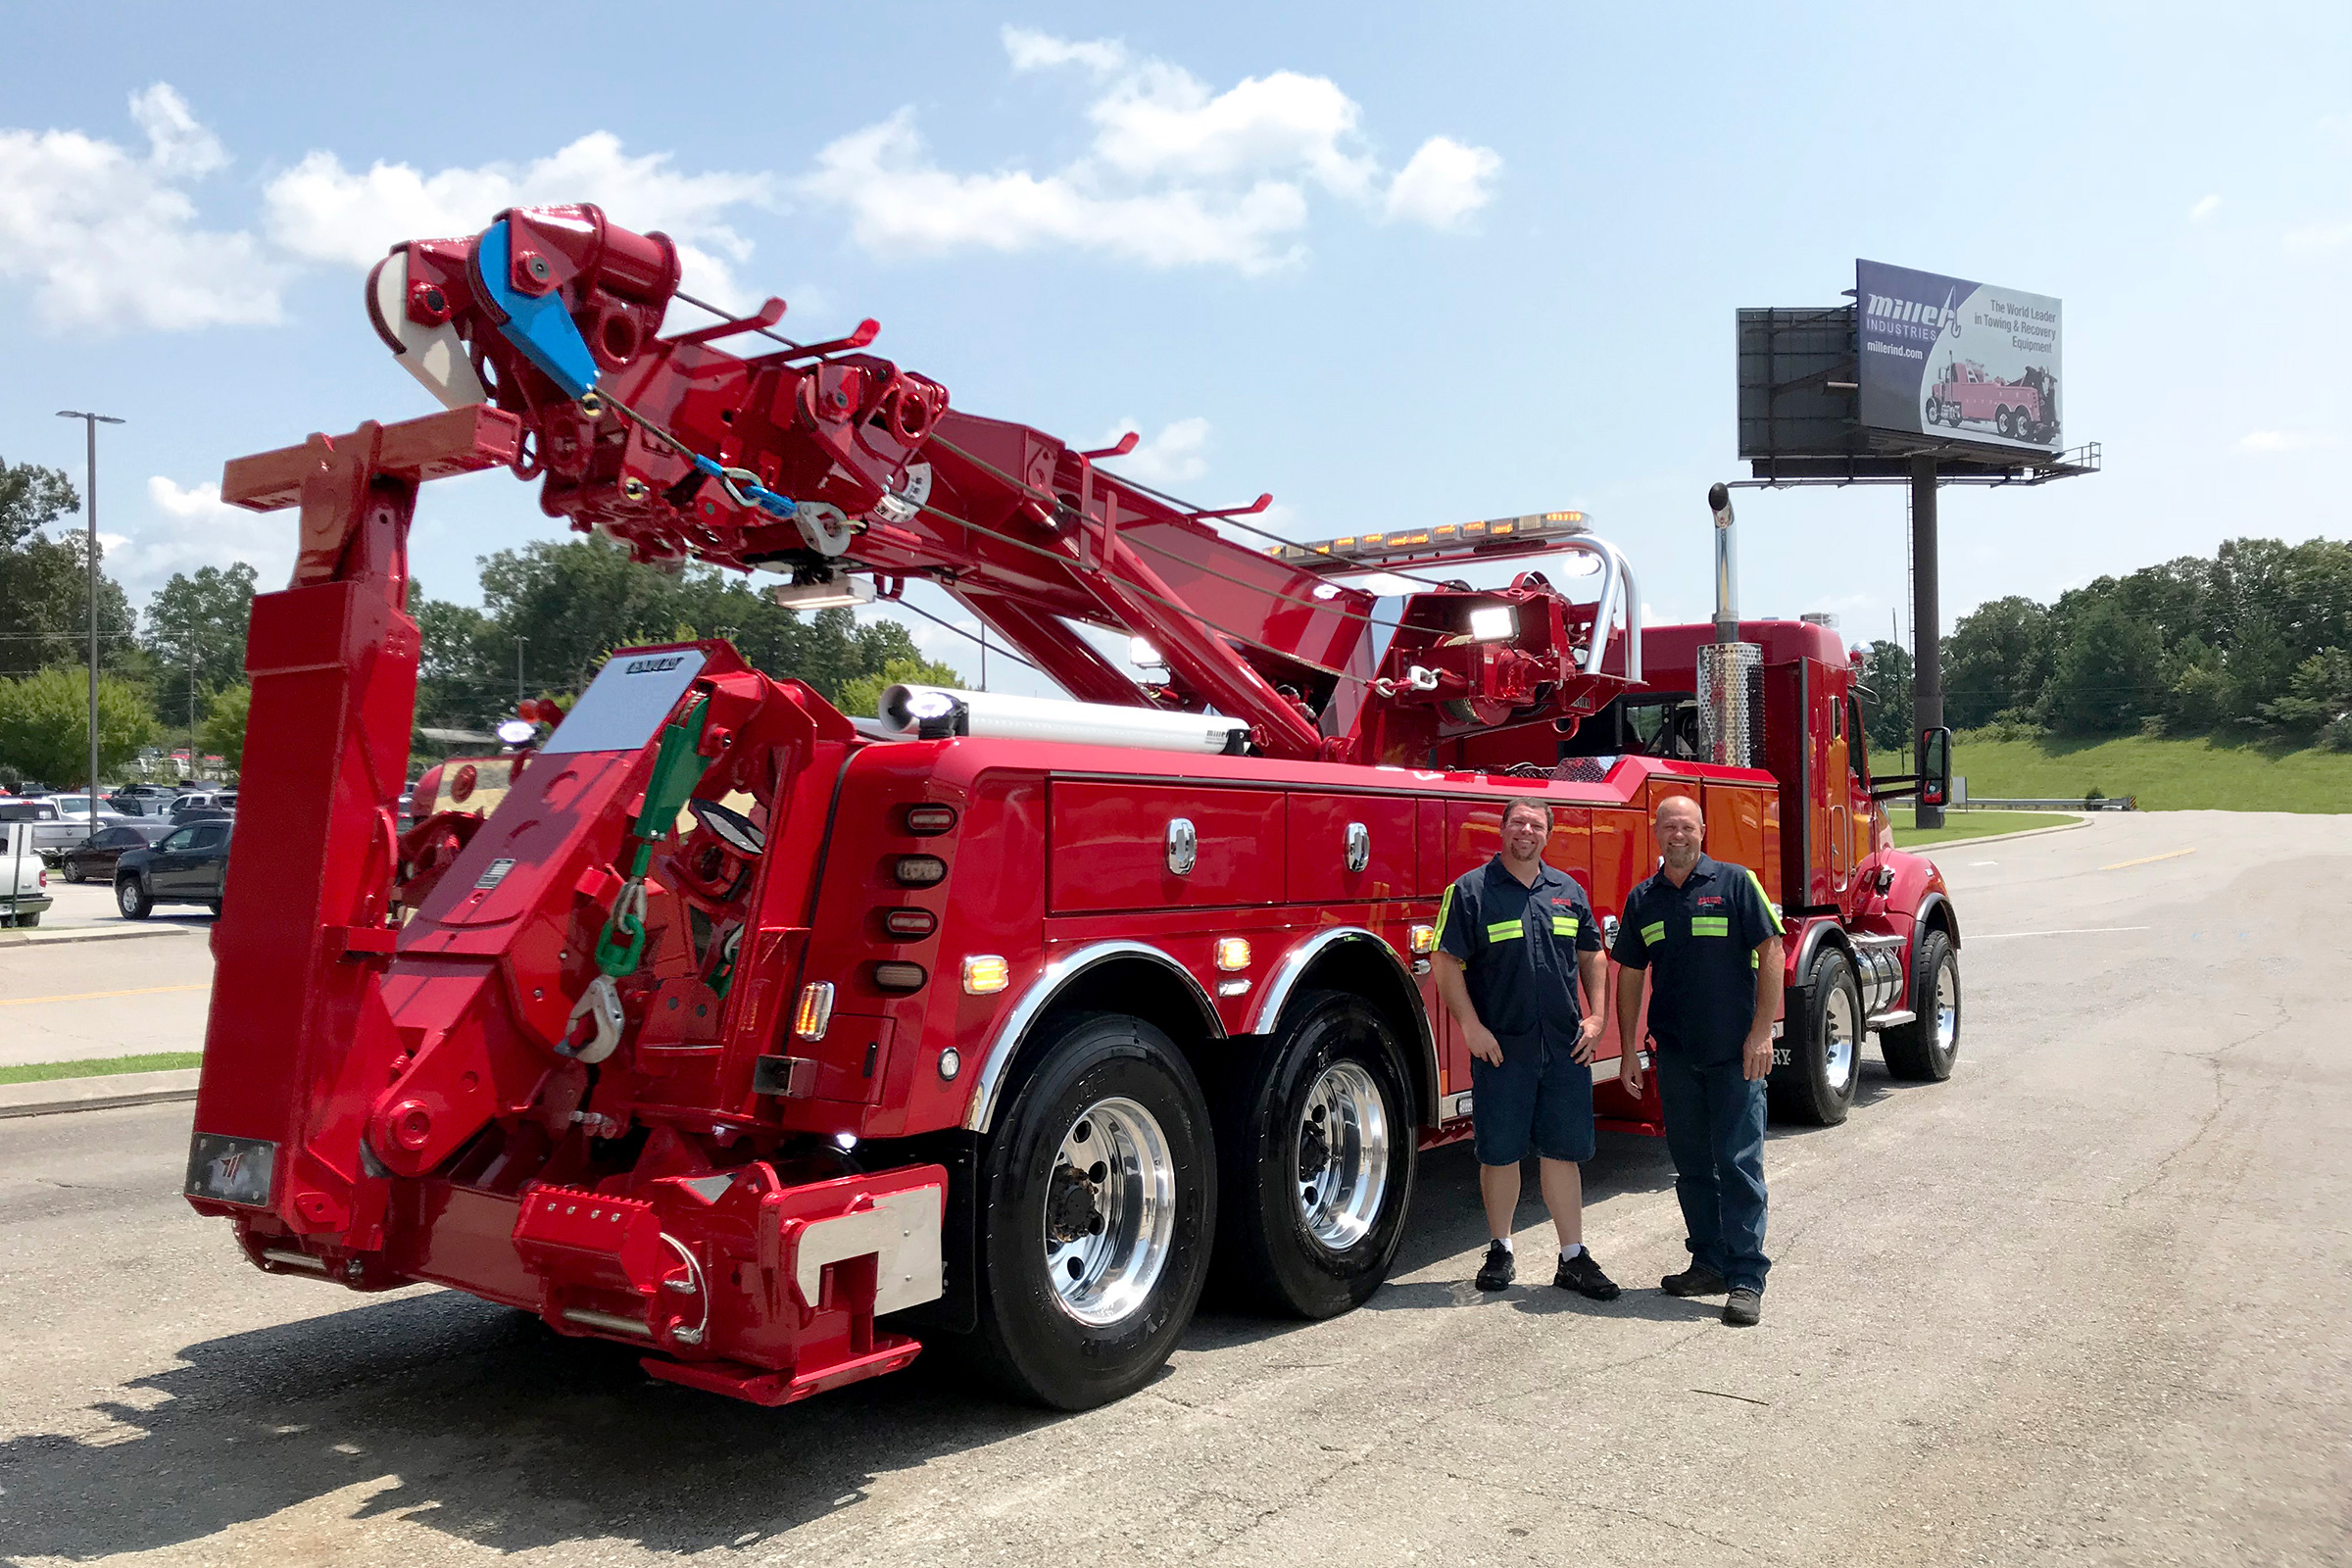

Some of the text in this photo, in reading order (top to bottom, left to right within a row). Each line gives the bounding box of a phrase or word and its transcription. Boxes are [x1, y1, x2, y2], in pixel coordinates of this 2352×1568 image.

[1990, 299, 2056, 323] The World Leader
[1866, 318, 1937, 341] INDUSTRIES
[1974, 312, 2056, 341] in Towing & Recovery
[1867, 340, 1923, 360] millerind.com
[2012, 335, 2052, 354] Equipment
